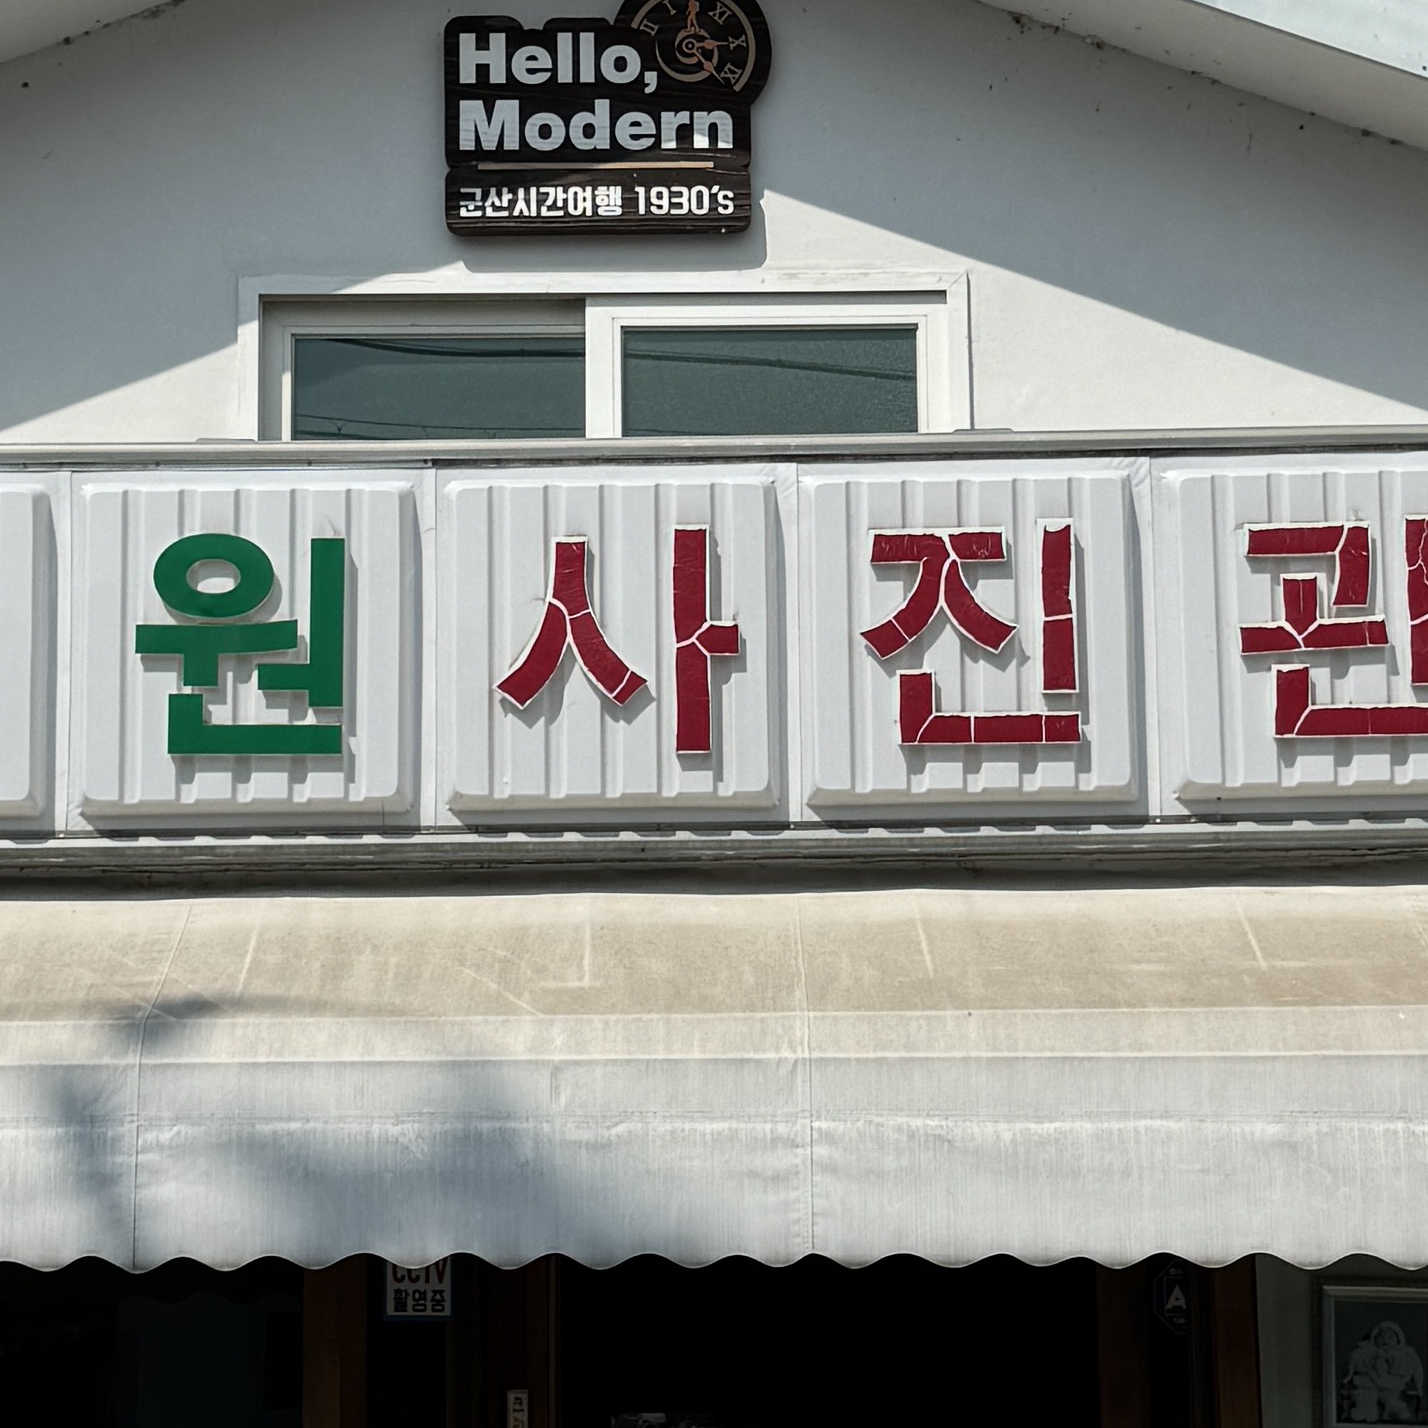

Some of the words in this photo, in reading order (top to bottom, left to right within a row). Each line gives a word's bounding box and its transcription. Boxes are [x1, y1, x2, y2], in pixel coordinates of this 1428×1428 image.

[459, 32, 658, 94] Hello,
[459, 99, 734, 151] Modern
[459, 186, 623, 218] 군산시간여행
[634, 185, 734, 215] 1930's
